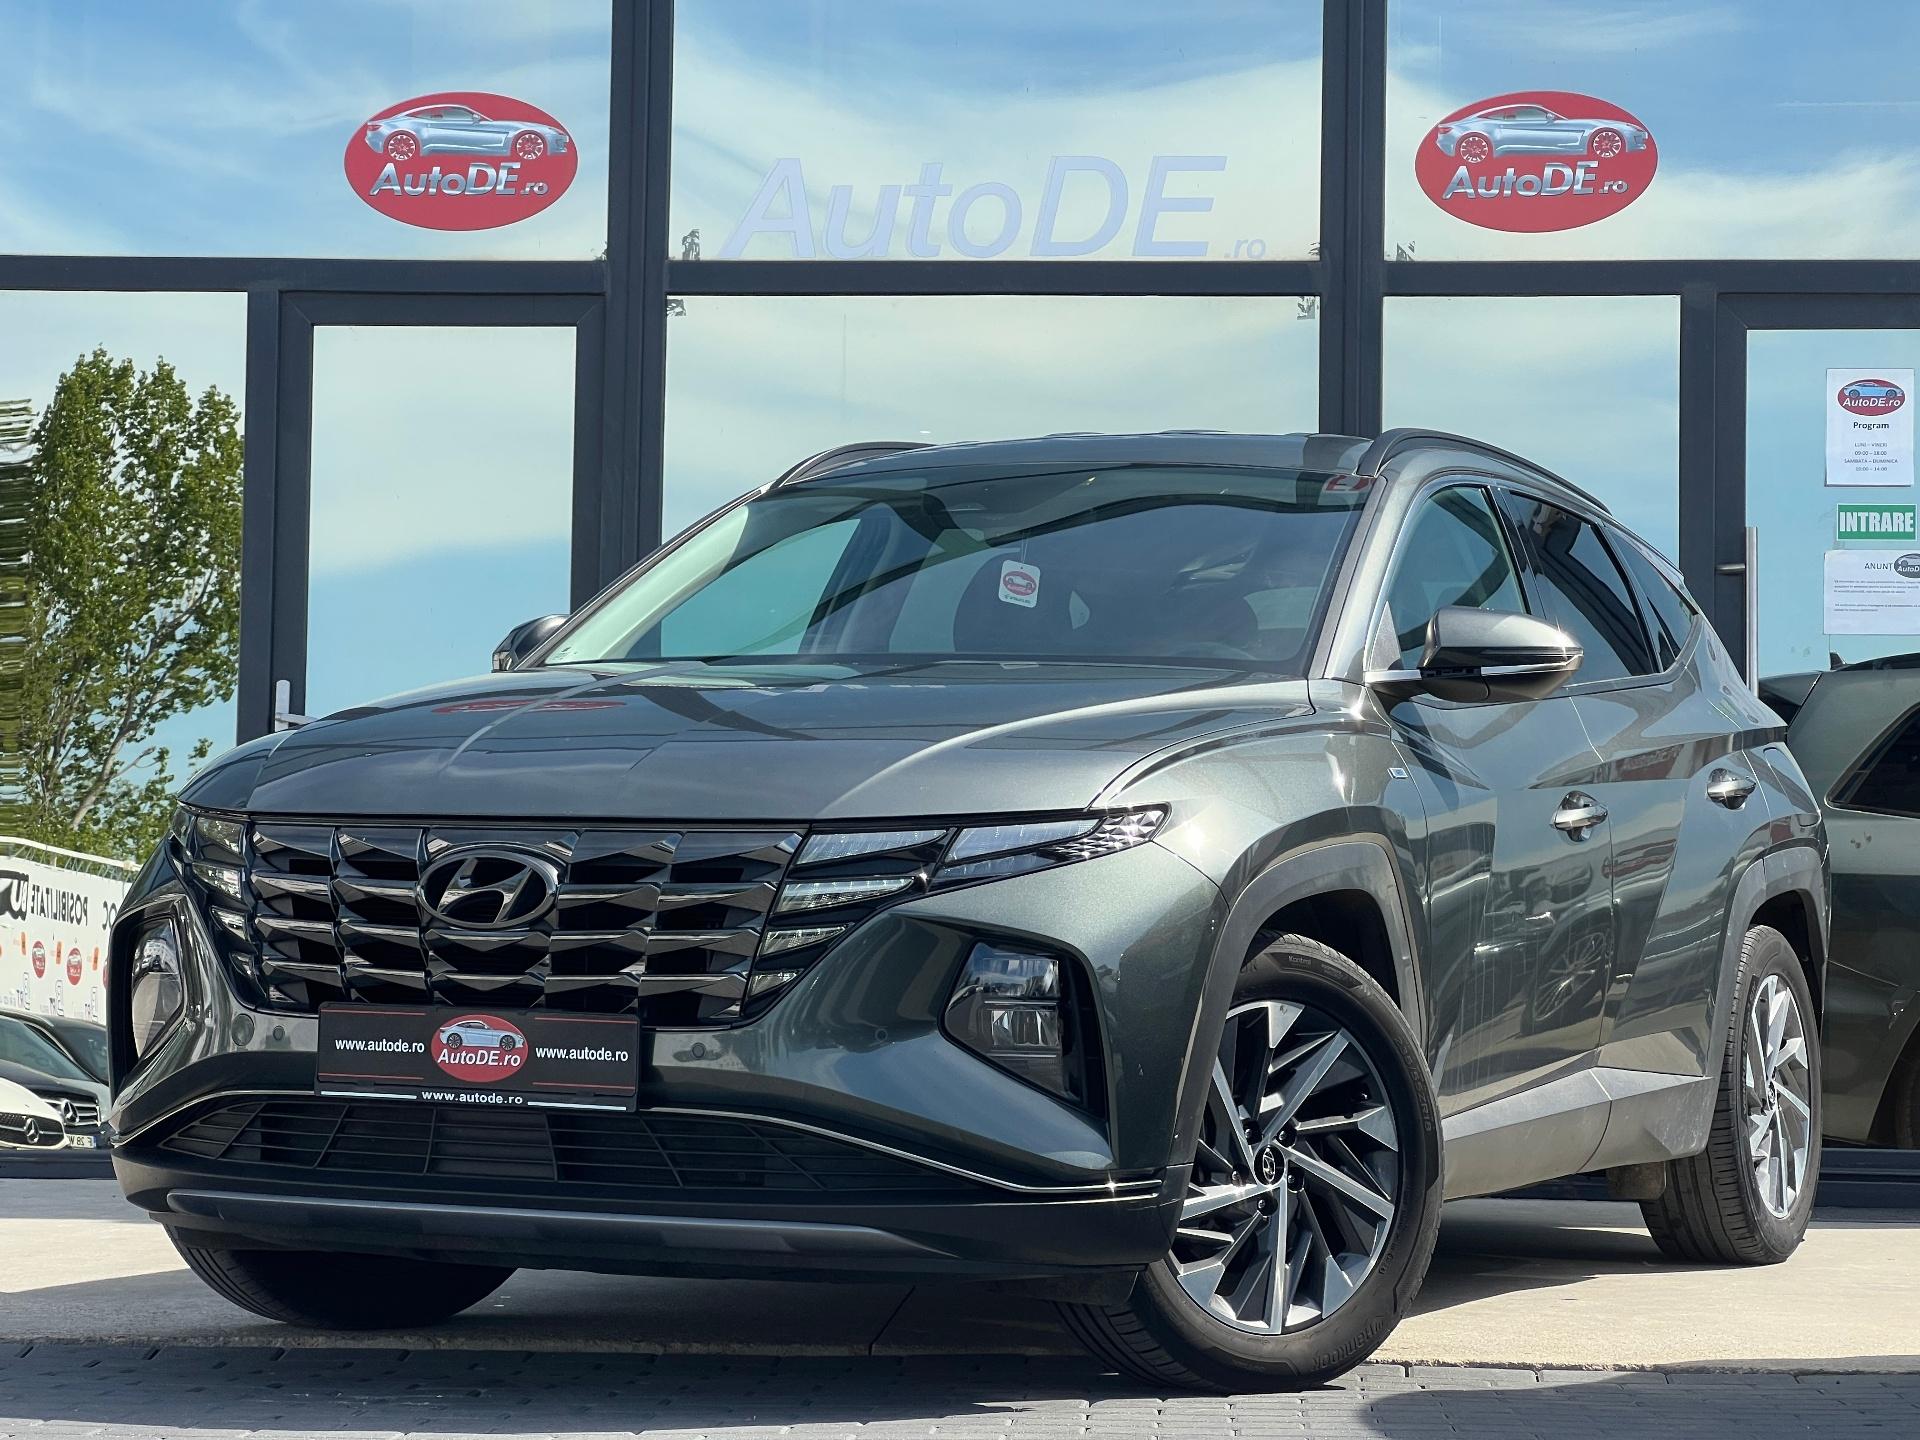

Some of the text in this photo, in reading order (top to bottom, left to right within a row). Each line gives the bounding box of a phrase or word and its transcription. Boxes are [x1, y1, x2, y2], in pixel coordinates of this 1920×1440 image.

[1842, 397, 1901, 407] AutoDE.ro
[1853, 421, 1890, 431] Program
[1839, 511, 1914, 533] INTRARE
[335, 1037, 425, 1054] www.autode.ro
[535, 1045, 629, 1062] www.autode.ro
[437, 1047, 522, 1068] AutoDE.ro
[421, 1090, 524, 1105] www.autode.ro
